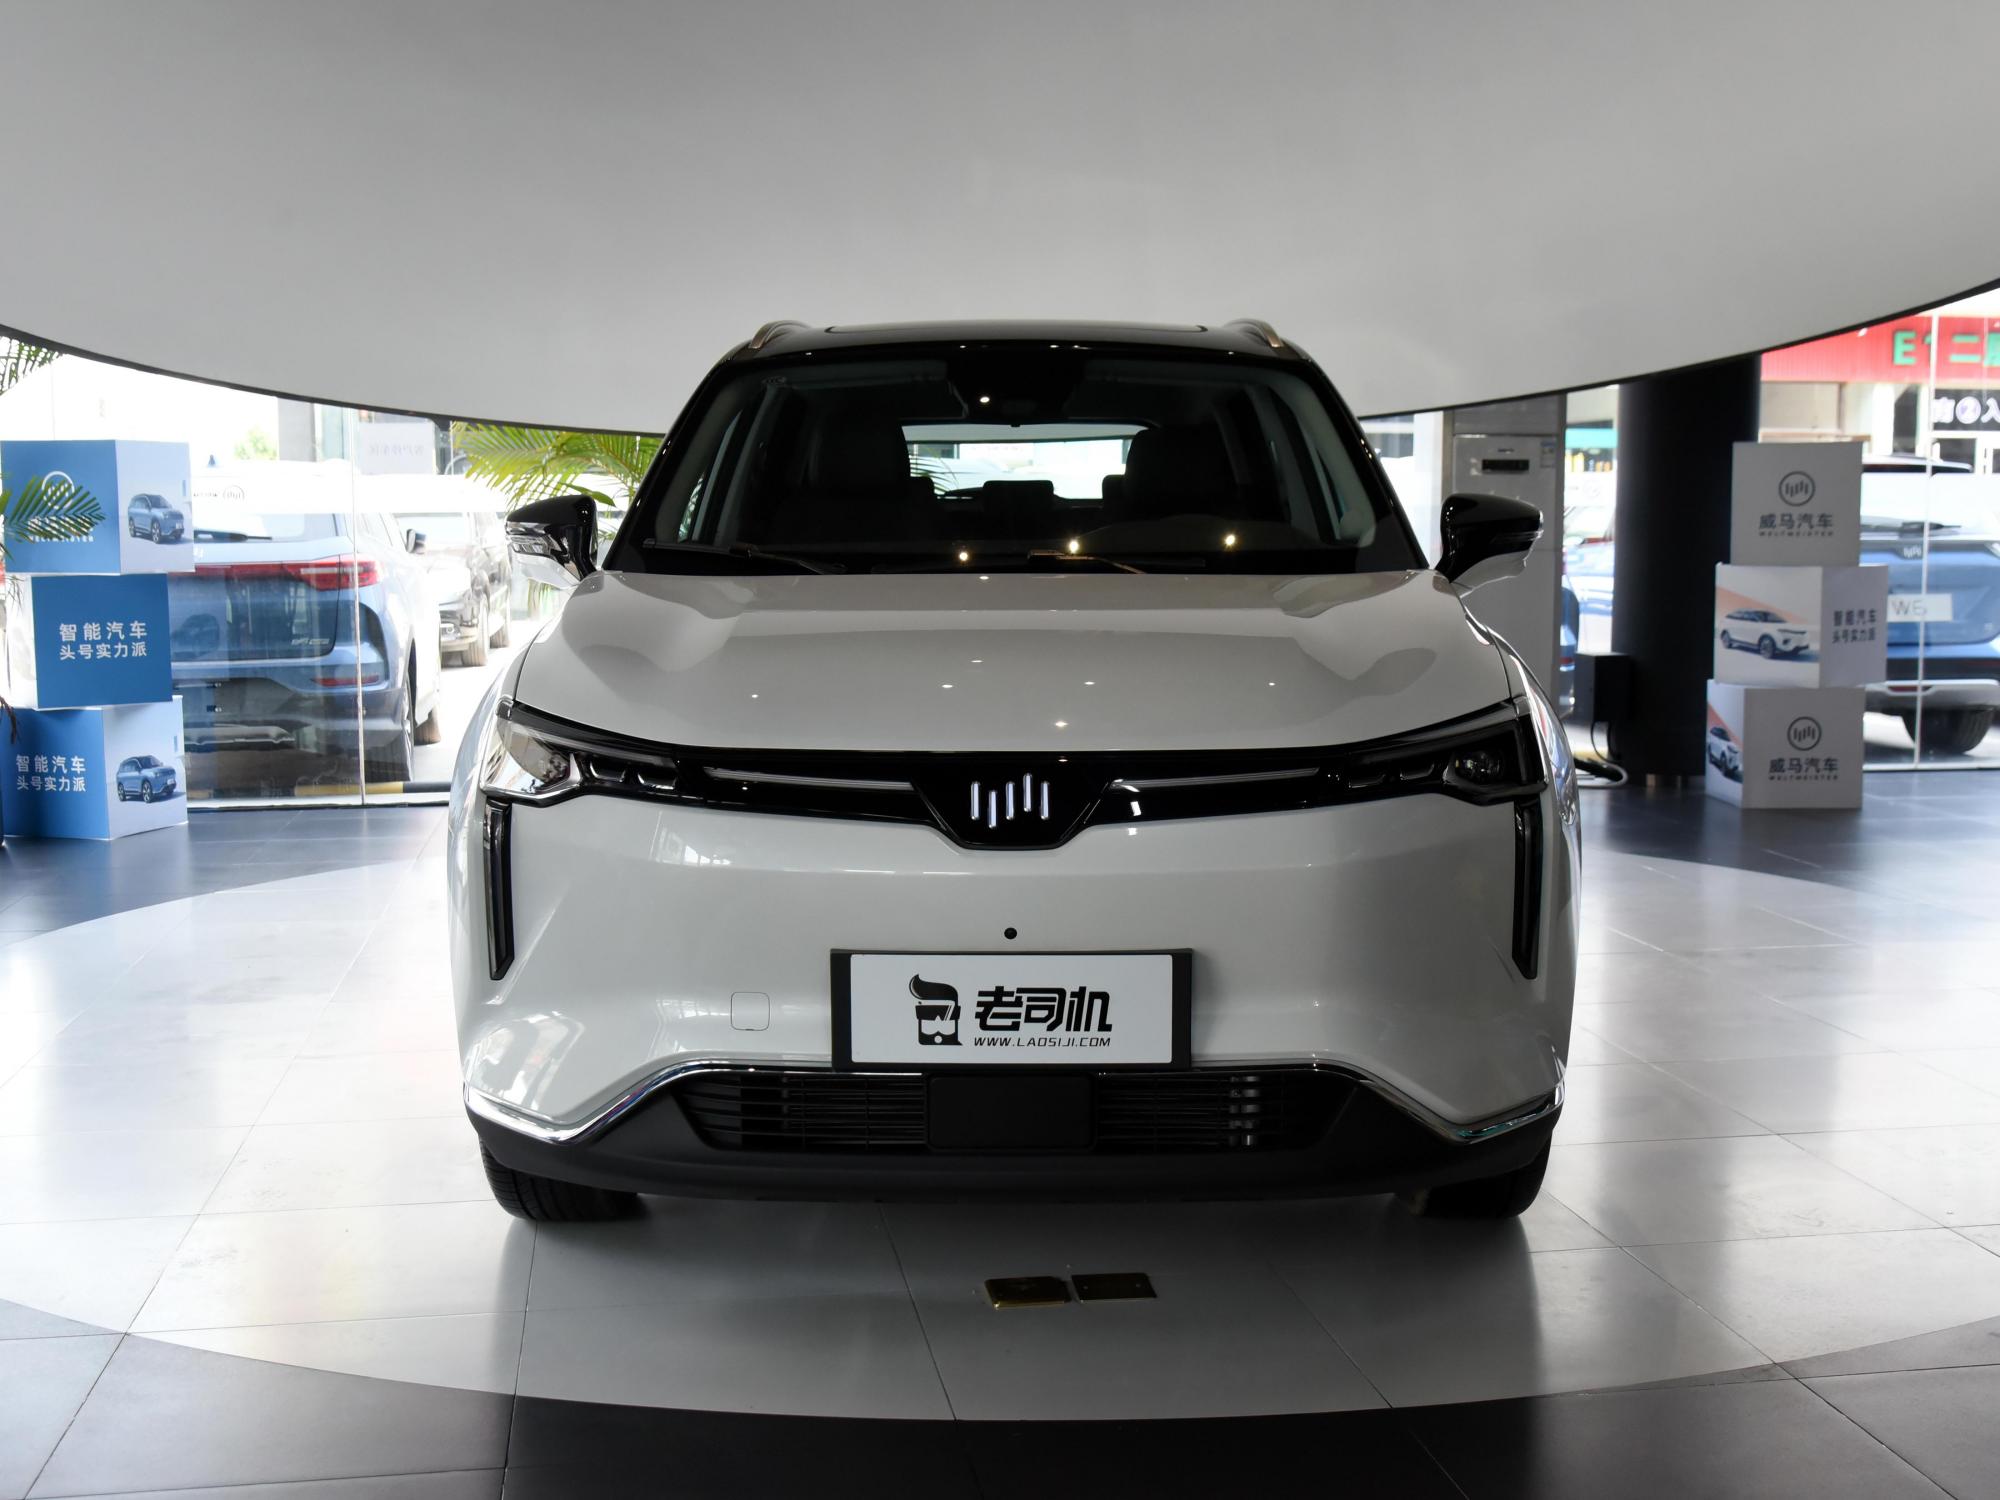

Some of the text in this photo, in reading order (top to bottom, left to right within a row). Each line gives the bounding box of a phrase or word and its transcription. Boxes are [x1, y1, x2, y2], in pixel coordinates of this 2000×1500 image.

[59, 621, 147, 641] 智能汽车
[60, 642, 147, 660] 头号实力派
[16, 754, 86, 774] 智能汽车
[17, 775, 86, 792] 头号实力派
[974, 986, 1113, 1032] 老司机
[974, 1037, 1111, 1047] WWW.LAOSIJI.COM
